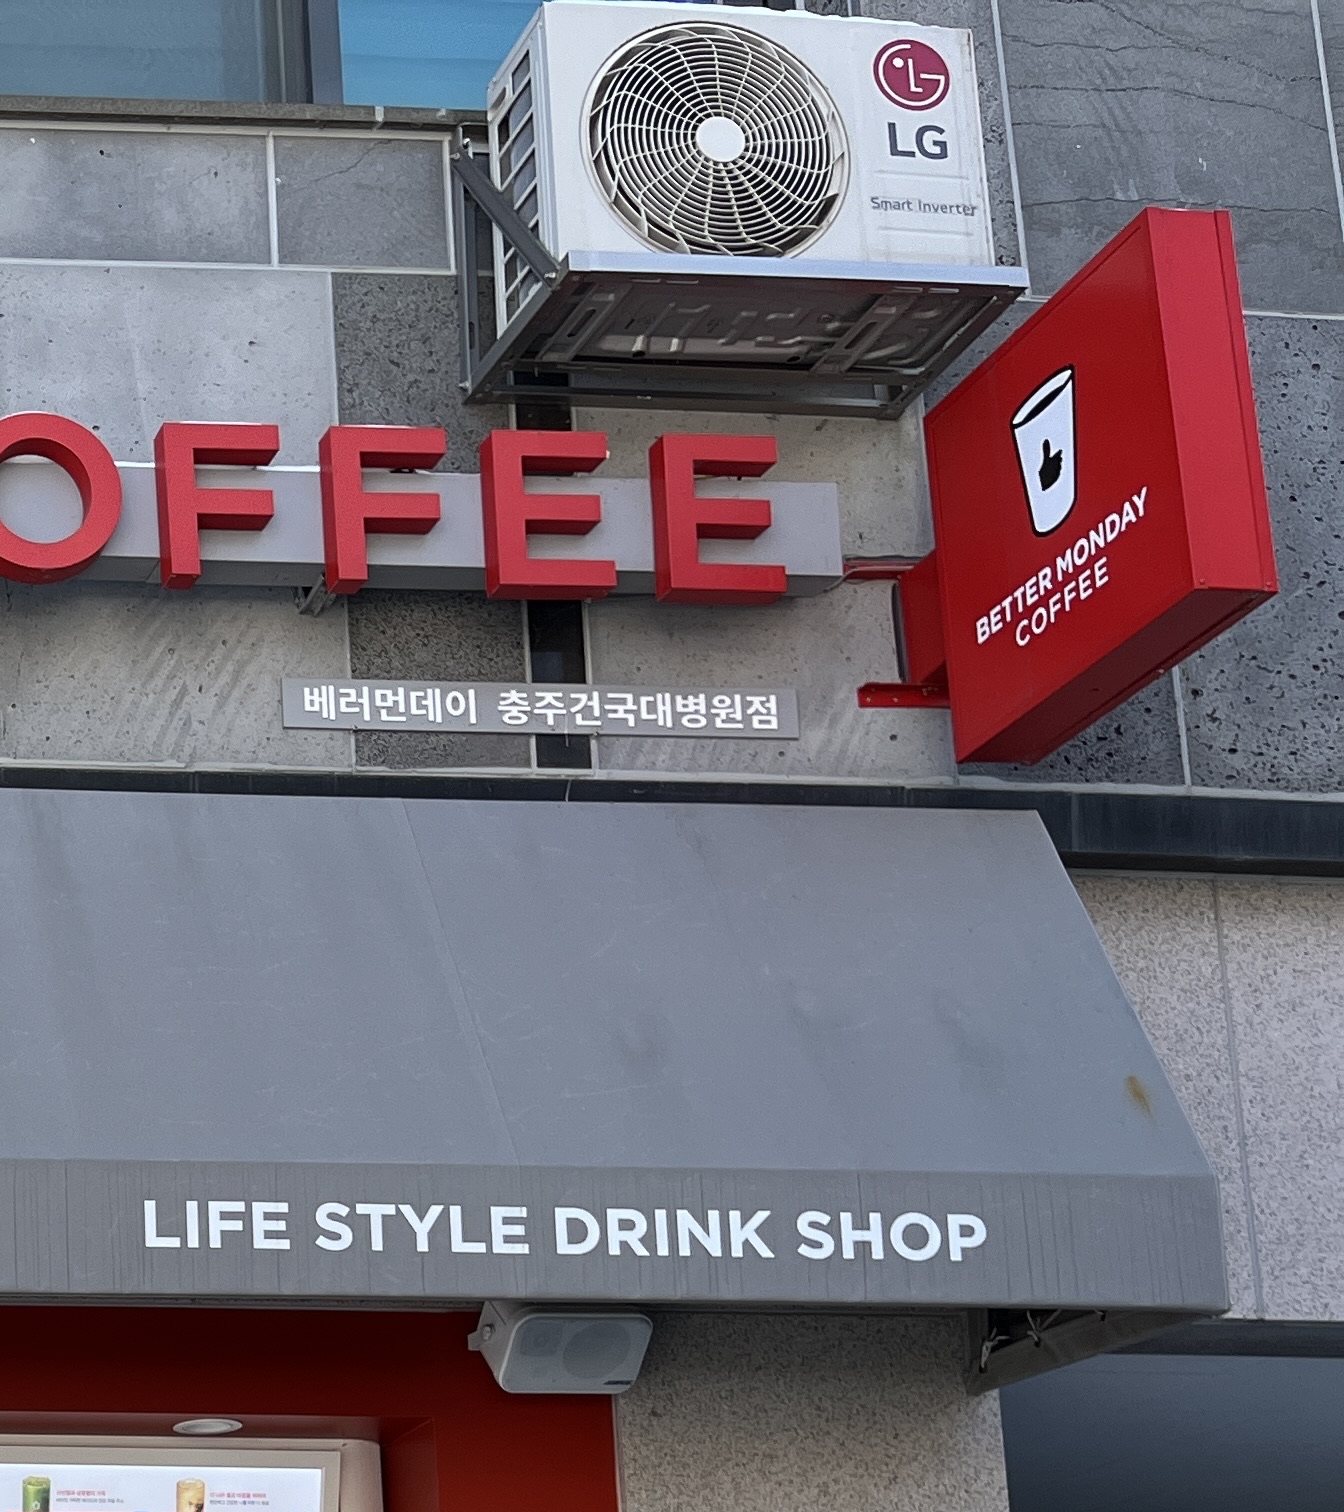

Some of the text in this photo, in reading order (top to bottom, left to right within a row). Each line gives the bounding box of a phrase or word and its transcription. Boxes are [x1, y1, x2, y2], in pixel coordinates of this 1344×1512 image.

[888, 122, 948, 160] LG
[871, 196, 979, 217] Smart Inverter
[975, 487, 1148, 645] BETTER MONDAY
[1015, 556, 1109, 647] COFFEE
[304, 685, 778, 729] 베러먼데이 충주건국대병원점
[144, 1199, 987, 1261] LIFE STYLE DRINK SHOP
